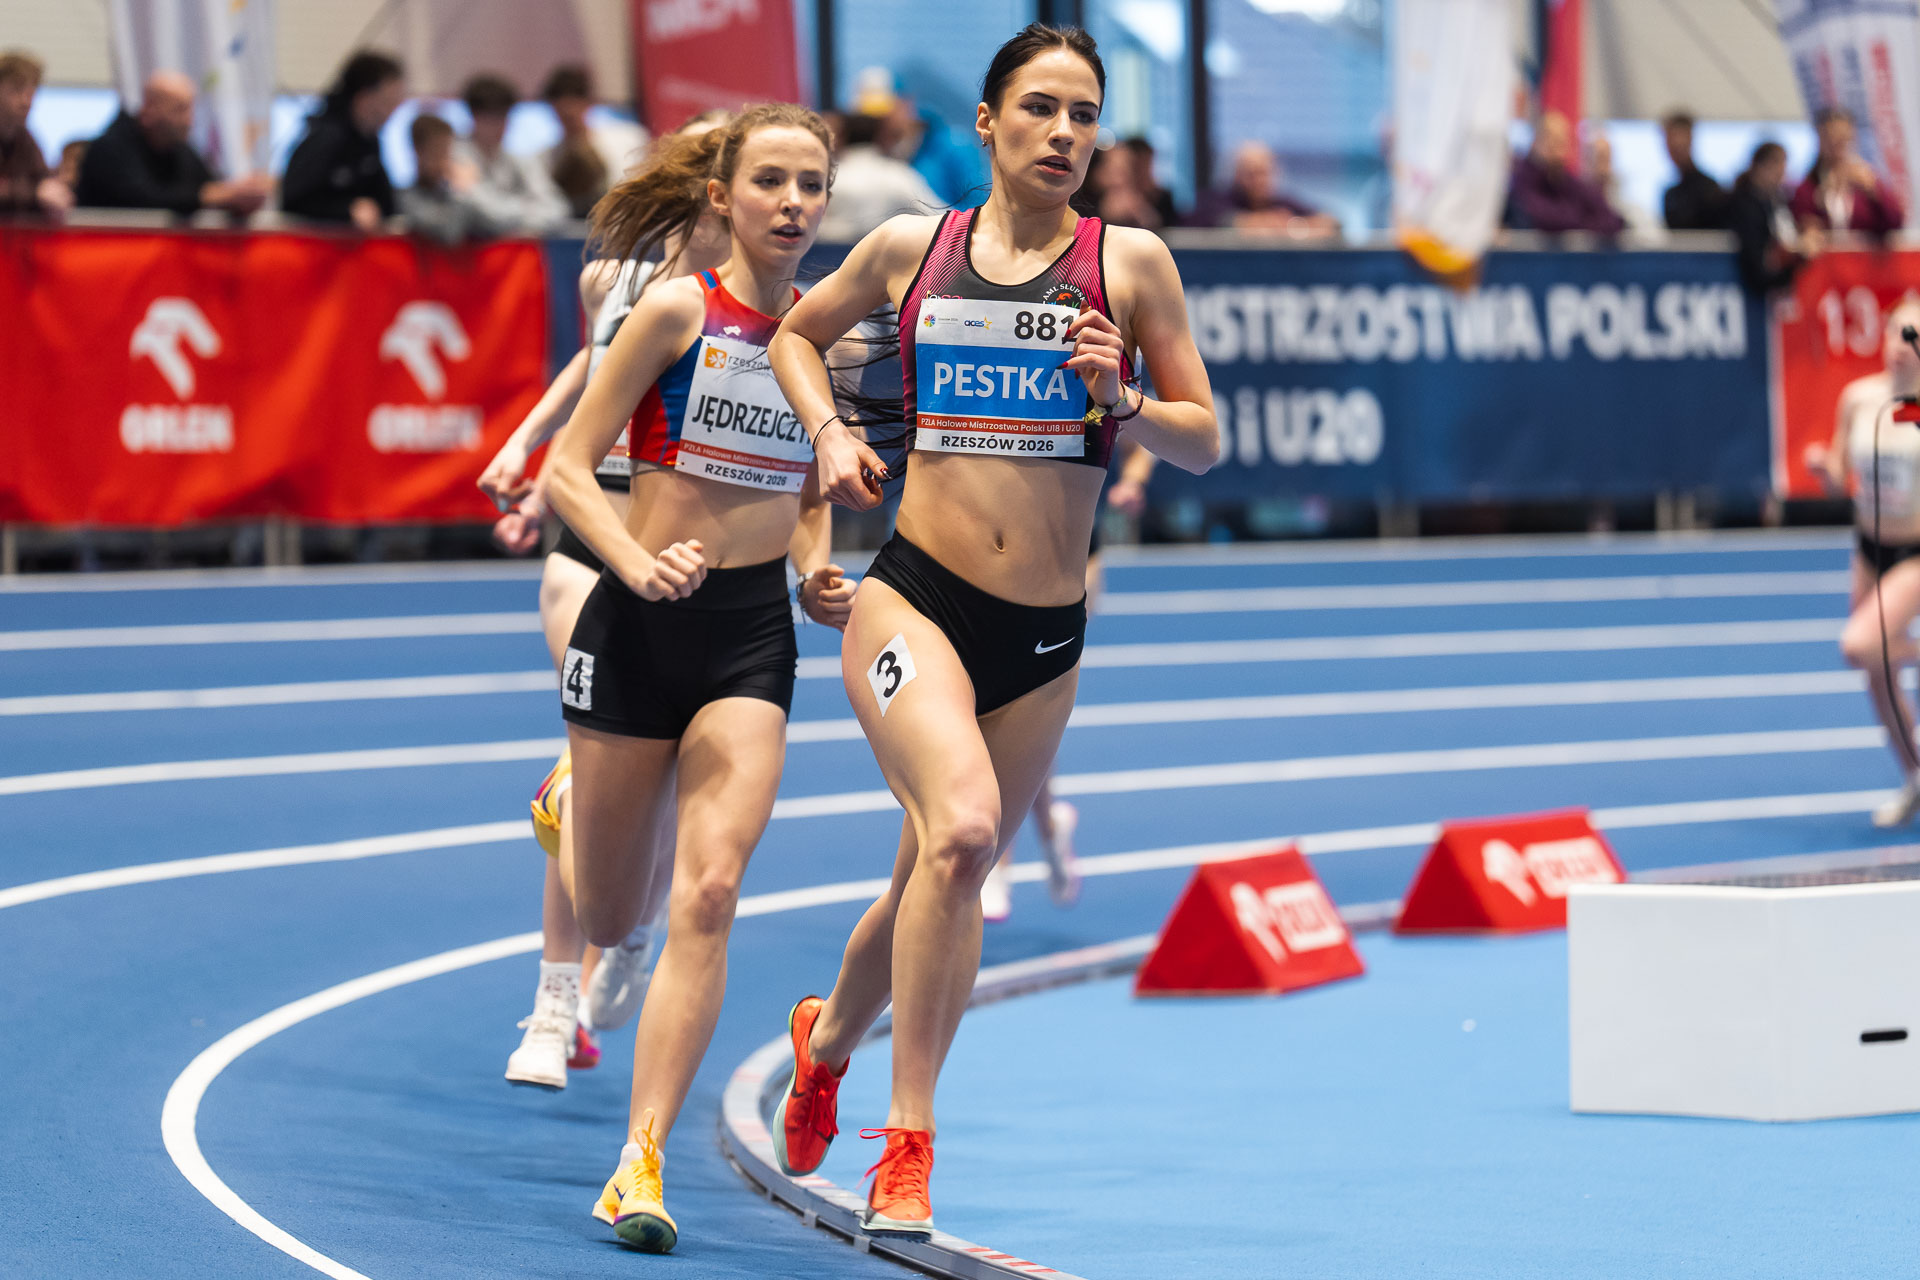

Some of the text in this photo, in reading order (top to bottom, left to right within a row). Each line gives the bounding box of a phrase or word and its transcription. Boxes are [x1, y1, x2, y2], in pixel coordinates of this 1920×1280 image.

[1184, 283, 1747, 362] ISTRZOSTWA POLSKI
[933, 362, 1069, 400] PESTKA
[691, 394, 811, 445] JĘDRZEJCZY
[921, 417, 1081, 432] PZLA Halowe Mistrzostwa Polski U18 i U20
[1264, 387, 1384, 466] U20
[683, 442, 702, 453] PZLA
[702, 448, 732, 460] Halowe
[941, 435, 1054, 451] RZESZÓW 2026
[705, 463, 787, 486] RZESZÓW 2026
[566, 657, 584, 703] 4
[877, 651, 903, 698] 3
